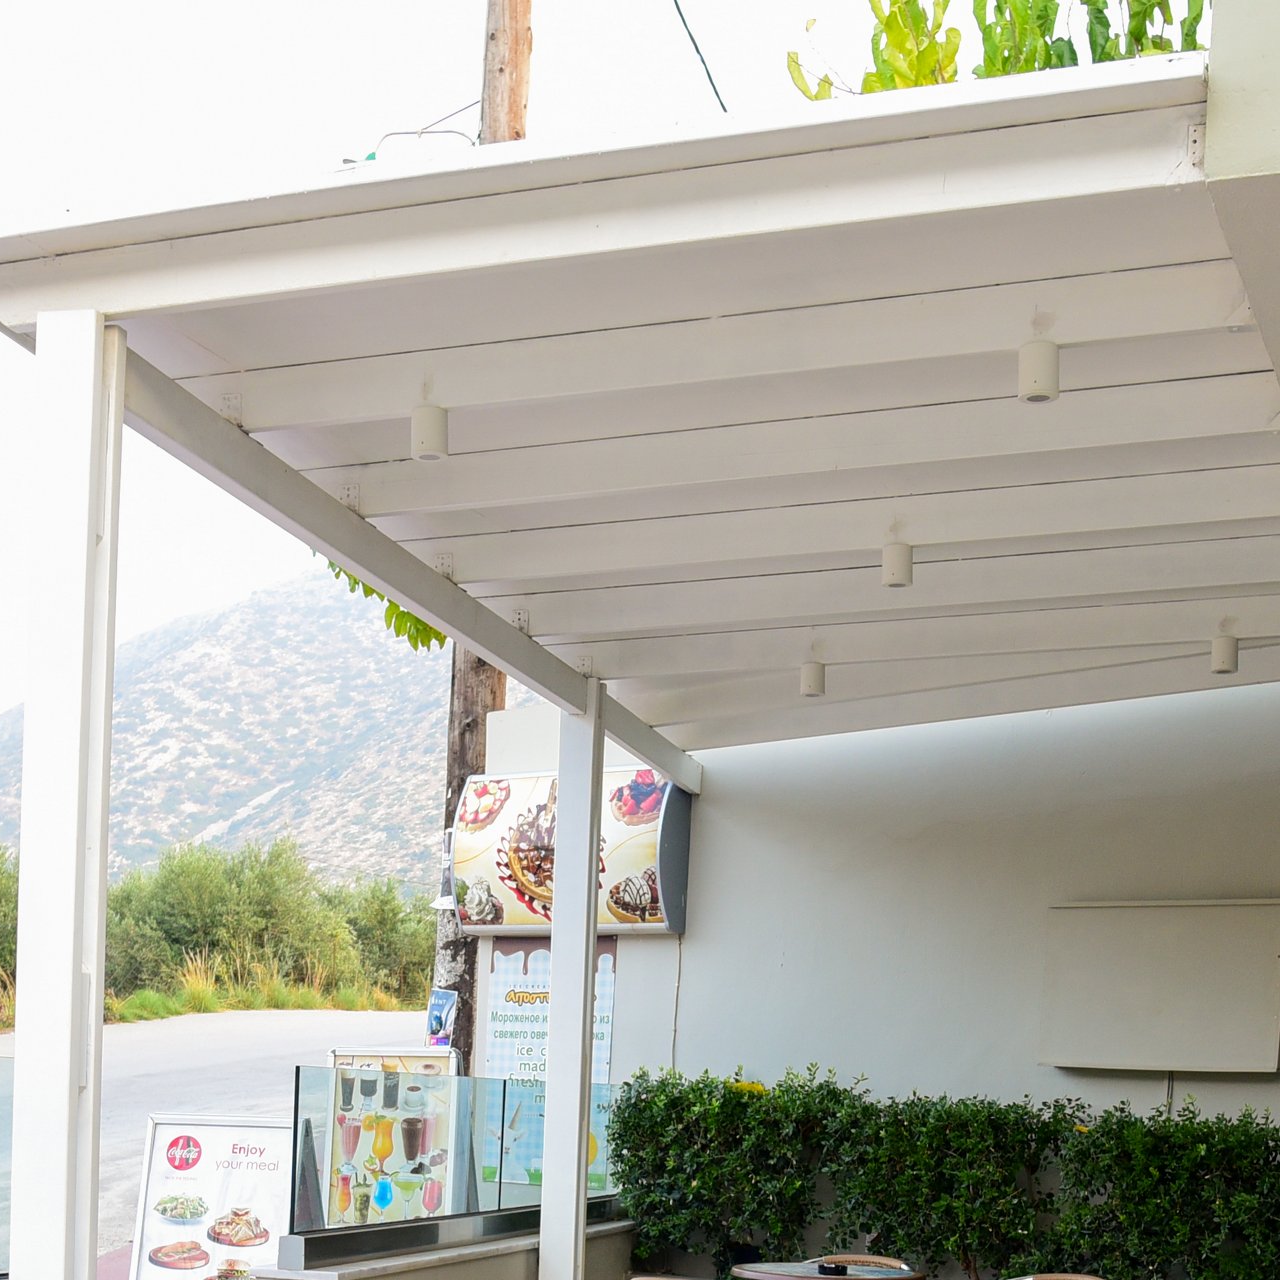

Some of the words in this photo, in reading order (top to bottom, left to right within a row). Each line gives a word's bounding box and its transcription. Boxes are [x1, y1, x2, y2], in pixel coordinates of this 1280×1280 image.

[491, 1011, 540, 1025] Мороженое
[494, 1030, 528, 1041] свежего
[517, 1043, 533, 1056] ice
[508, 1073, 542, 1088] fresh
[232, 1143, 266, 1158] Enjoy
[215, 1160, 242, 1171] your
[246, 1160, 279, 1172] meal
